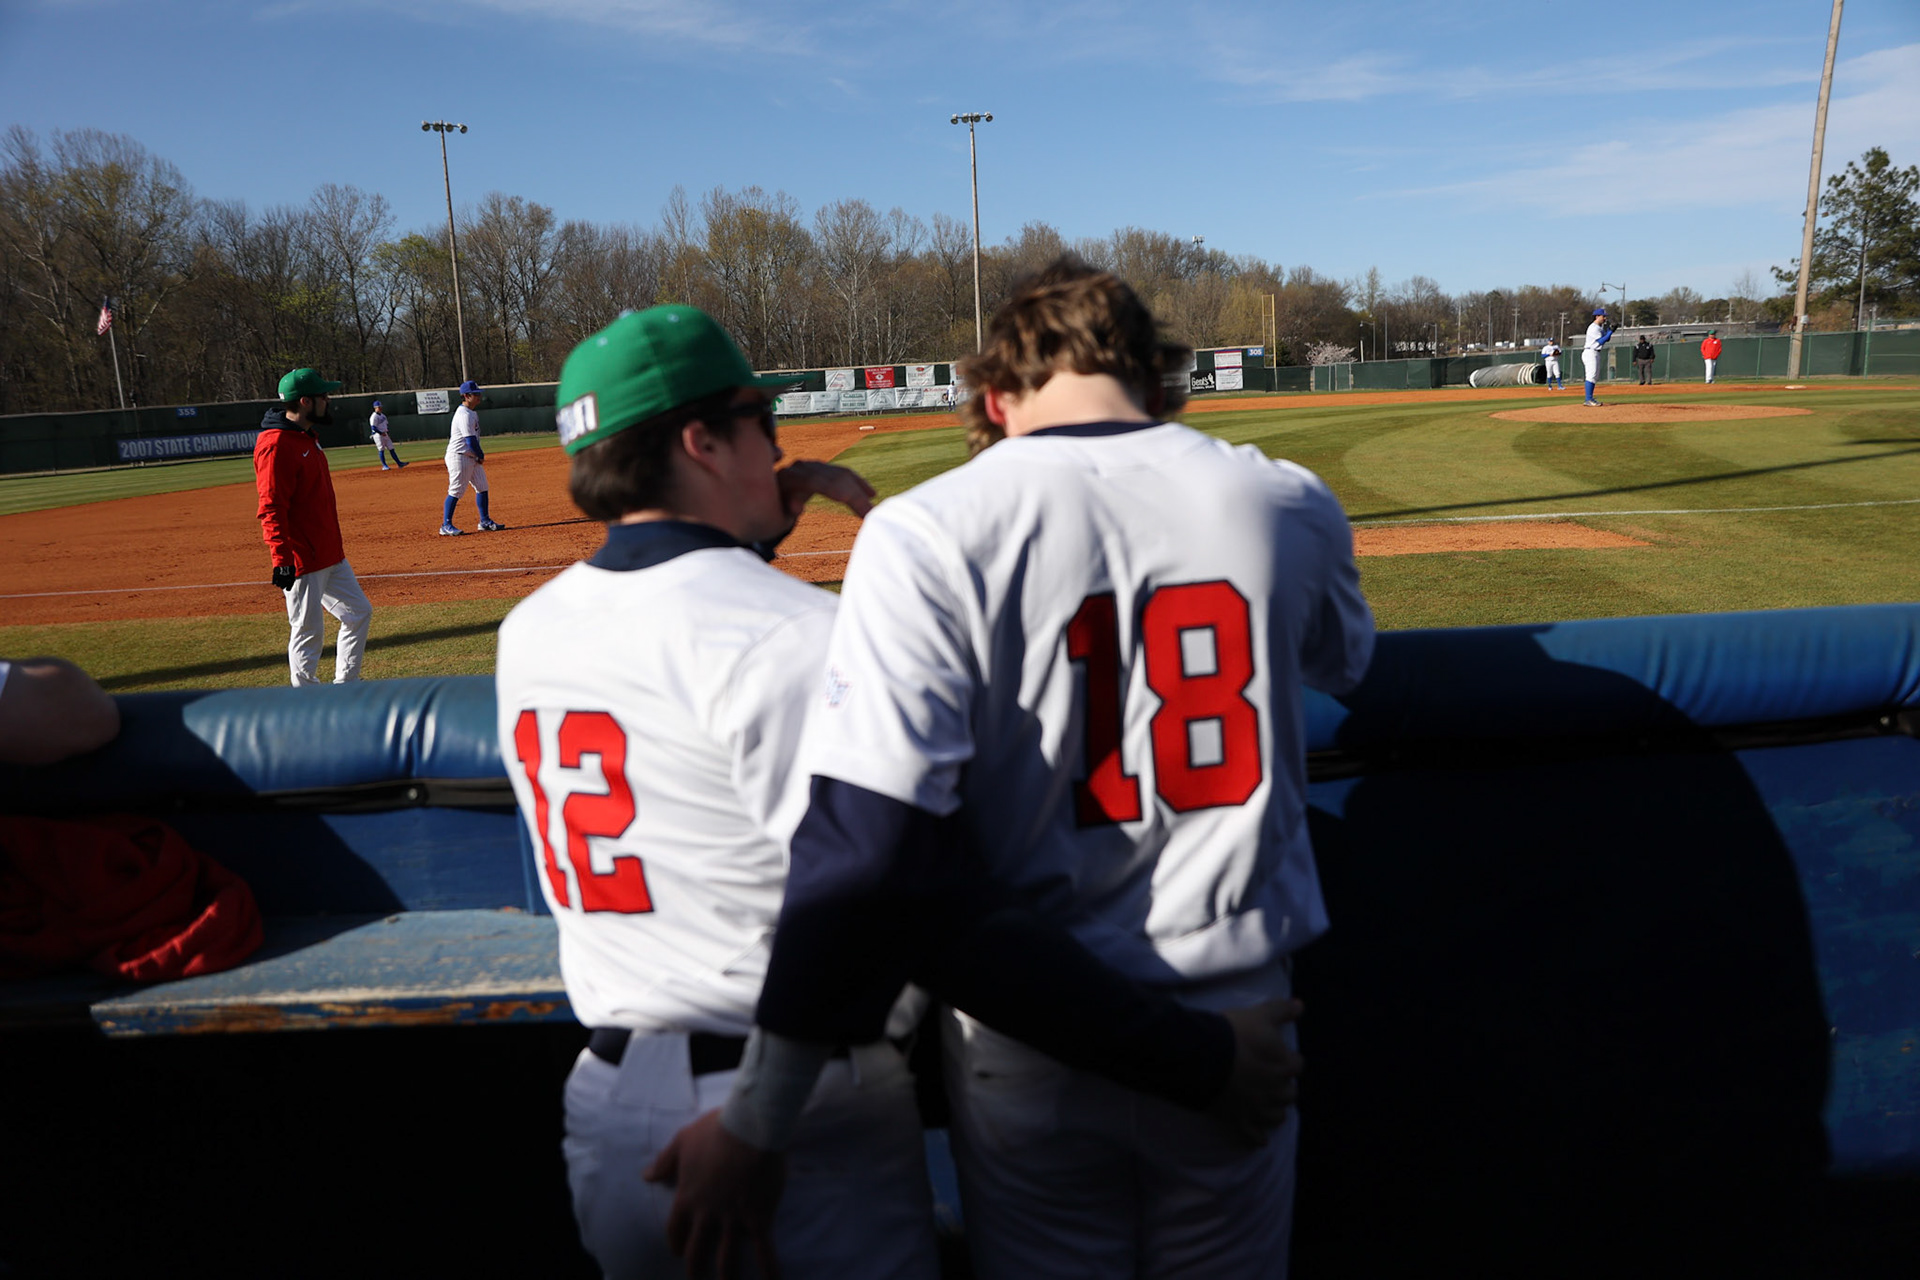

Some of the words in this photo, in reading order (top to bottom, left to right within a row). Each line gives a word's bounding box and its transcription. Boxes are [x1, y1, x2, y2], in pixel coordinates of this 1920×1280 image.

[120, 441, 153, 458] 2007
[155, 438, 192, 455] STATE
[193, 432, 259, 452] CHAMPION
[178, 408, 196, 416] 355
[1066, 580, 1263, 830] 18
[514, 709, 654, 914] 12
